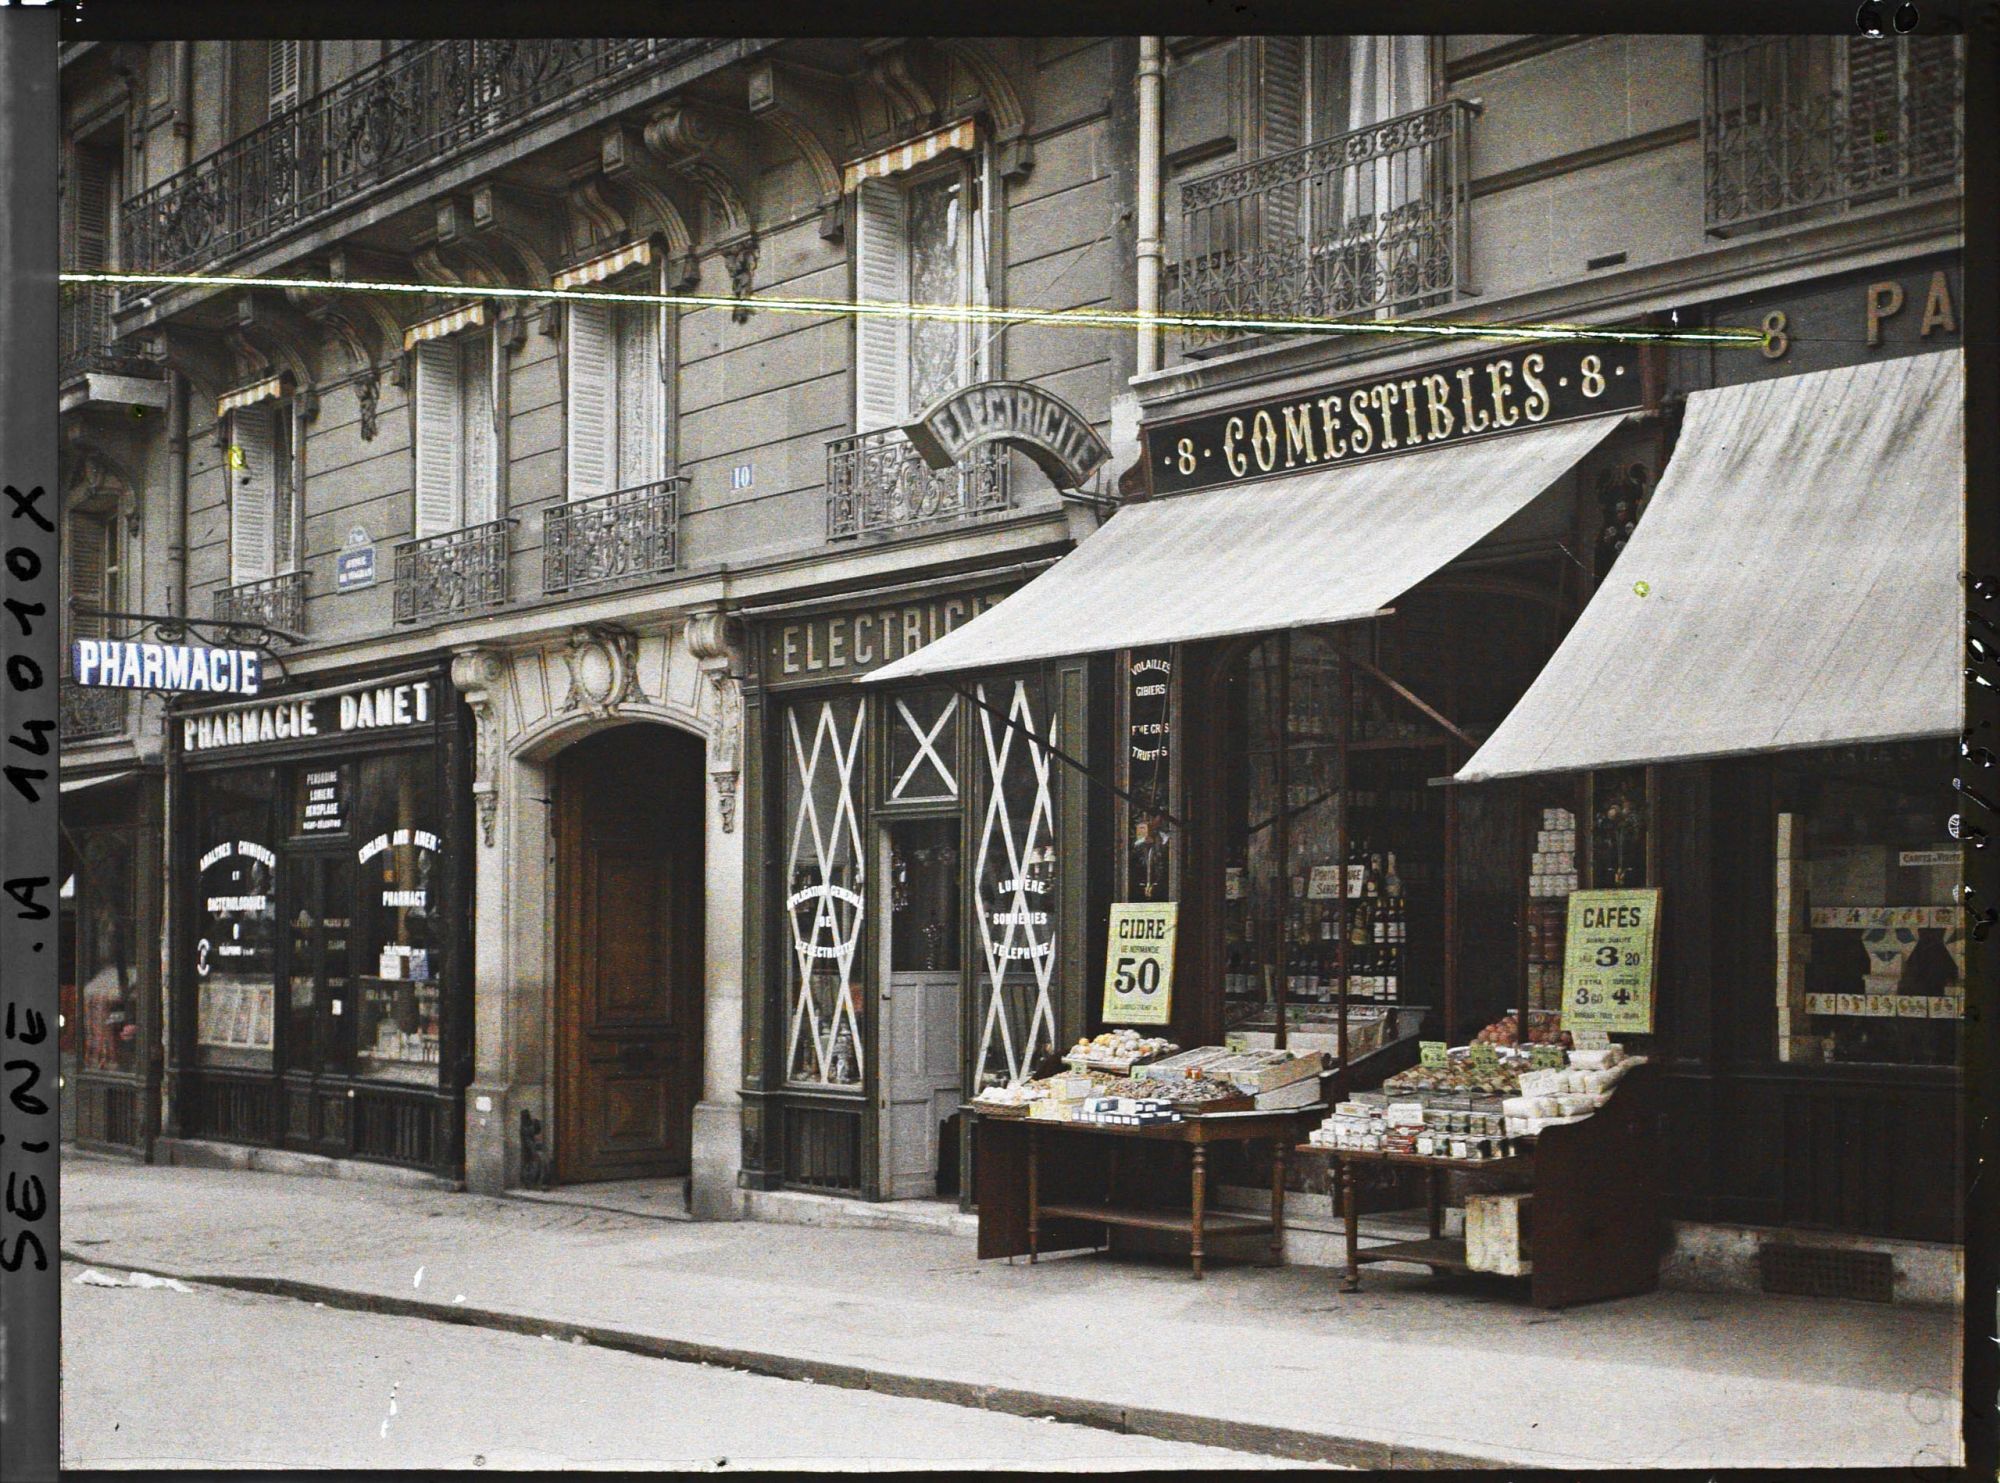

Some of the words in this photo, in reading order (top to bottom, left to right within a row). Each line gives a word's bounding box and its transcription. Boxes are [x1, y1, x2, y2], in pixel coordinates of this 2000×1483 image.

[1762, 310, 1787, 358] 8
[1866, 271, 1956, 346] PA
[1177, 438, 1196, 475] 8
[1222, 353, 1550, 477] COMESTIBLES
[1581, 355, 1606, 398] 8
[735, 466, 750, 488] 10
[784, 593, 1006, 674] ELECTRIC
[79, 640, 257, 694] PHARMACIE
[1131, 659, 1171, 676] VOLAILLES
[1135, 683, 1166, 697] GIBIERS
[184, 700, 318, 750] PHARMACIE
[340, 681, 430, 731] DANET
[1150, 722, 1170, 735] GRS
[393, 828, 409, 846] AND
[200, 841, 231, 872] ANALYSES
[239, 840, 275, 868] CHIMIQUES
[382, 890, 426, 907] PHARMACY
[993, 911, 1047, 925] SONNERIES
[1119, 919, 1165, 940] CIDRE
[1595, 946, 1619, 967] 3
[1625, 952, 1641, 966] 20
[1114, 957, 1160, 995] 50
[1575, 987, 1589, 1005] 3
[1612, 988, 1631, 1006] 4
